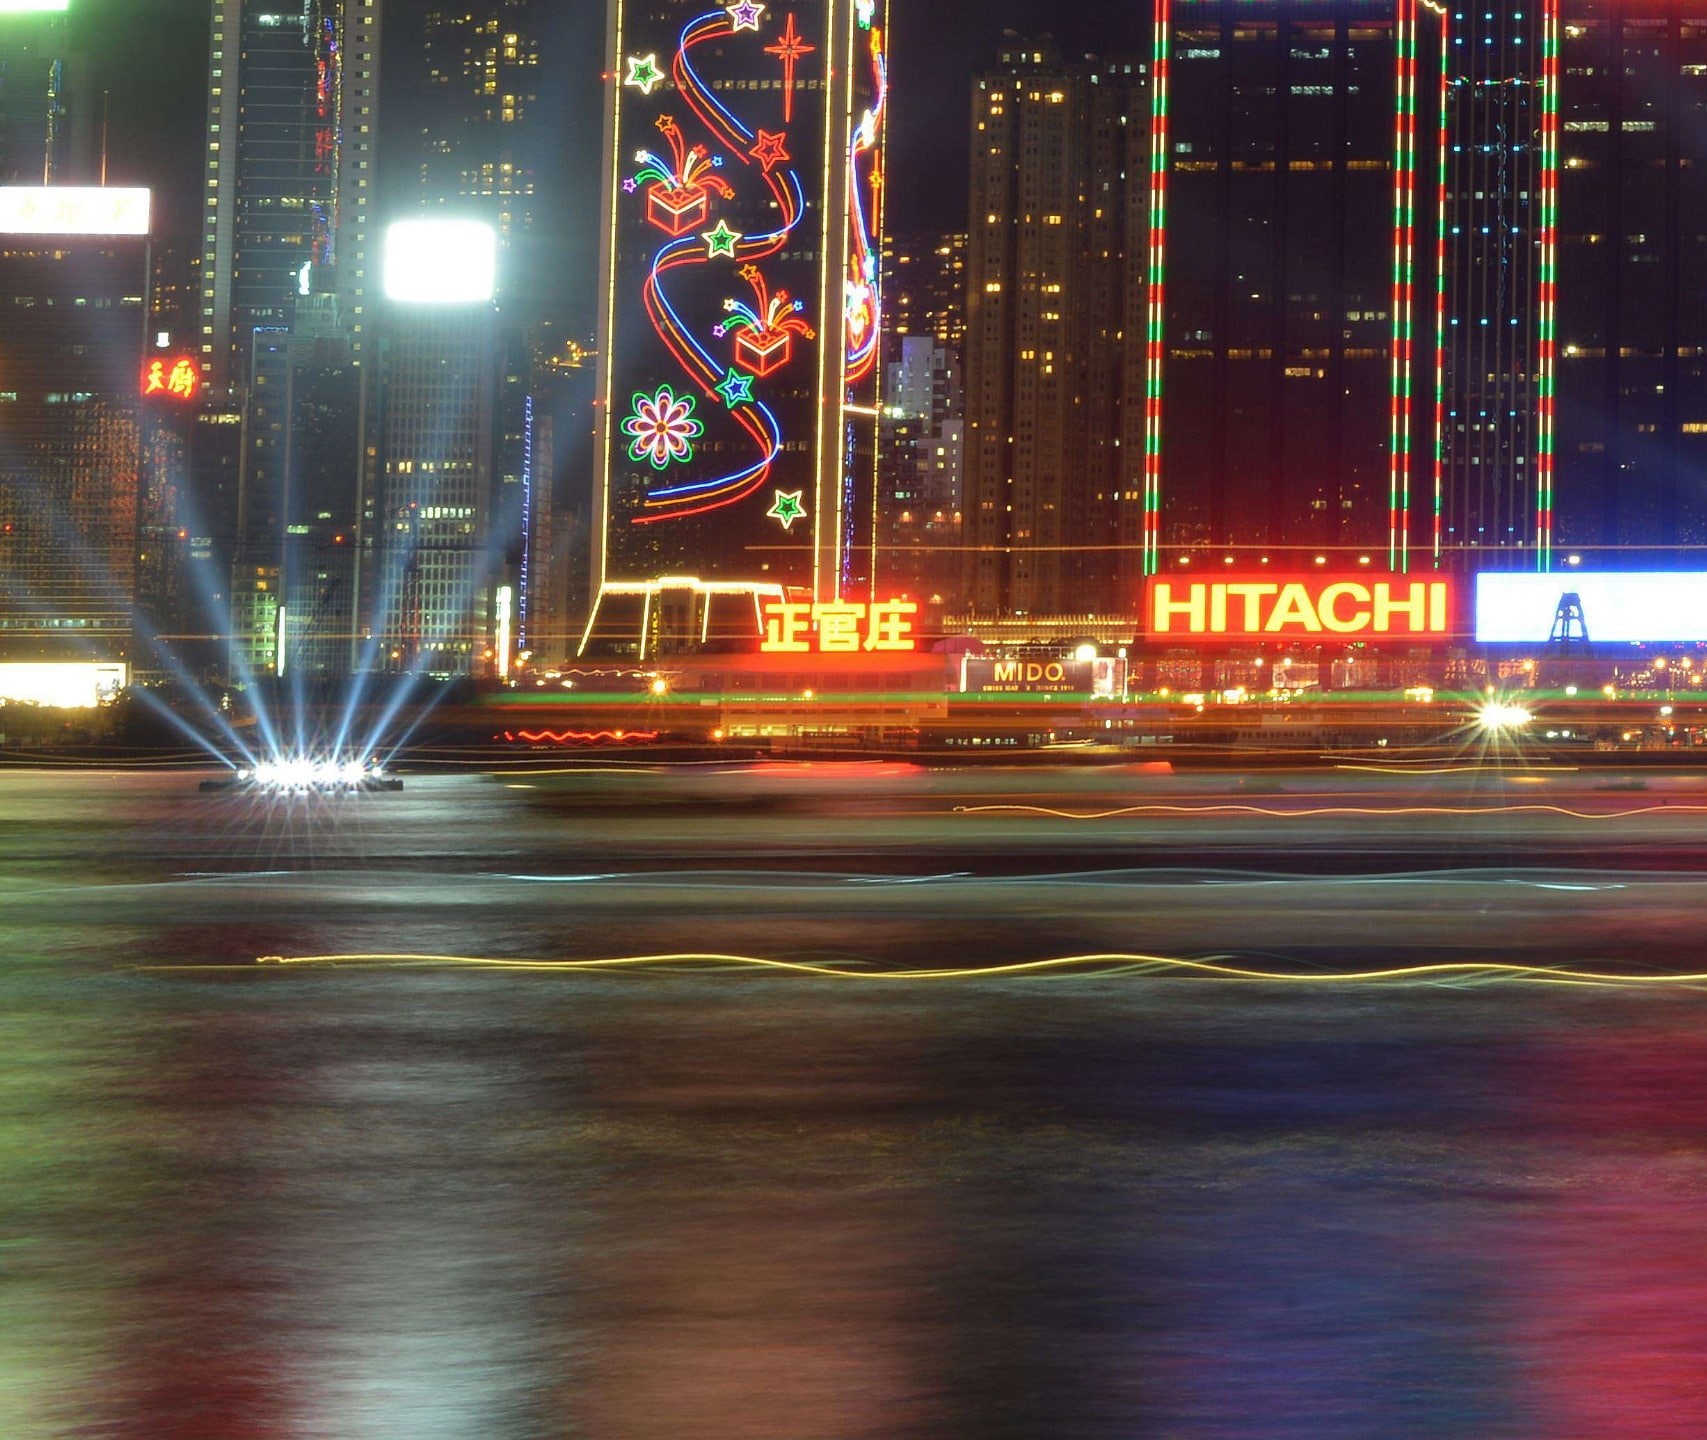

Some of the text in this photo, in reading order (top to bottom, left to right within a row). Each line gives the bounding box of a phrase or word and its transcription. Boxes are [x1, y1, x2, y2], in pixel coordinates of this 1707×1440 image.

[760, 598, 918, 652] 正官庄
[1154, 582, 1447, 633] HITACHI
